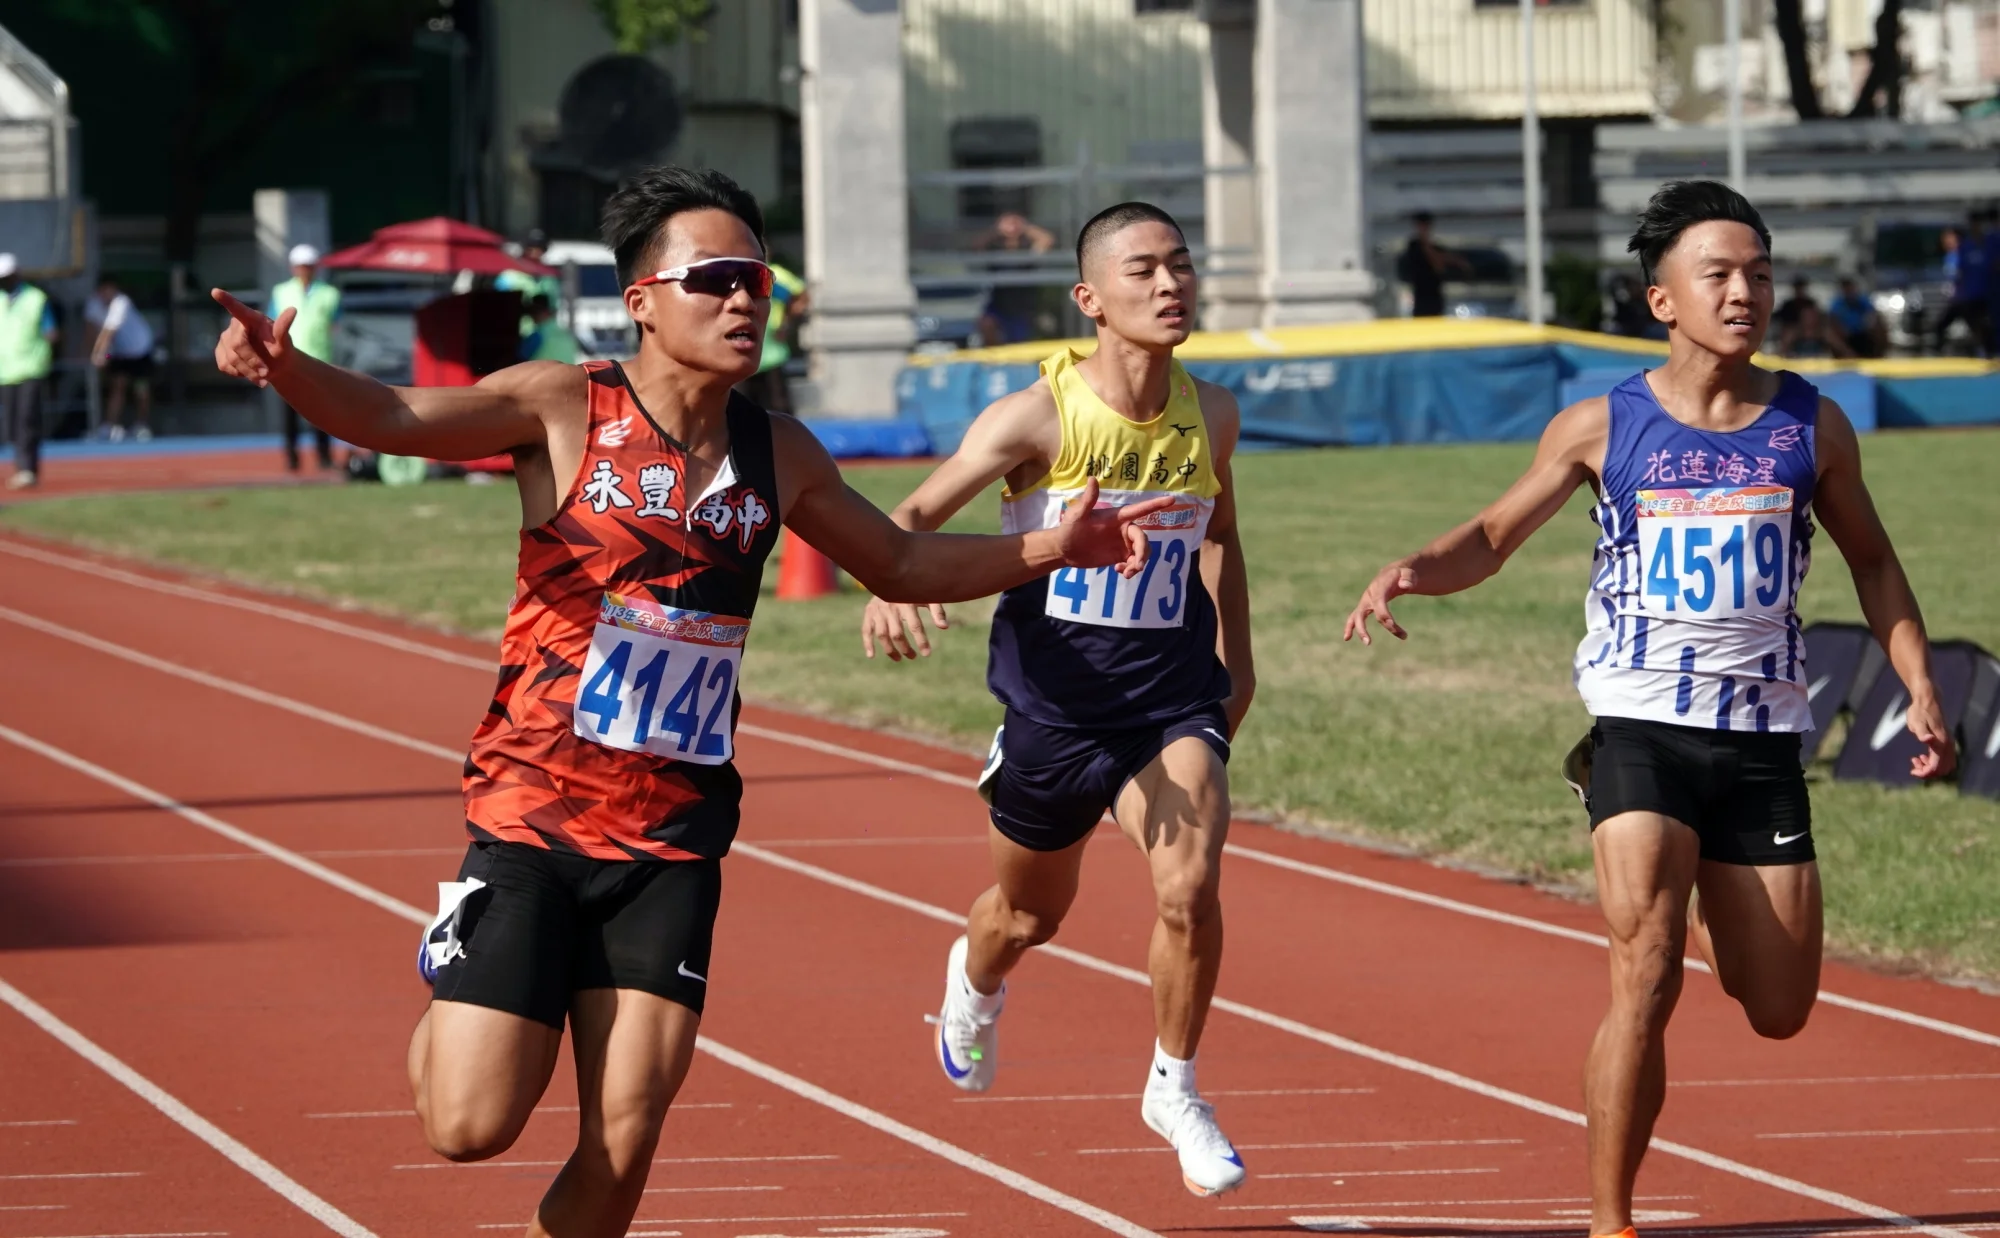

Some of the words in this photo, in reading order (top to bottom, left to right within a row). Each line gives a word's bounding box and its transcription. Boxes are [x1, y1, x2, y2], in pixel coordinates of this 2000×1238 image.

[580, 460, 768, 548] 永豐高中
[1086, 452, 1197, 487] 桃園高中
[1642, 449, 1781, 486] 花蓮海星
[1054, 539, 1186, 621] 4173
[1647, 523, 1783, 613] 4519
[579, 640, 733, 756] 4142
